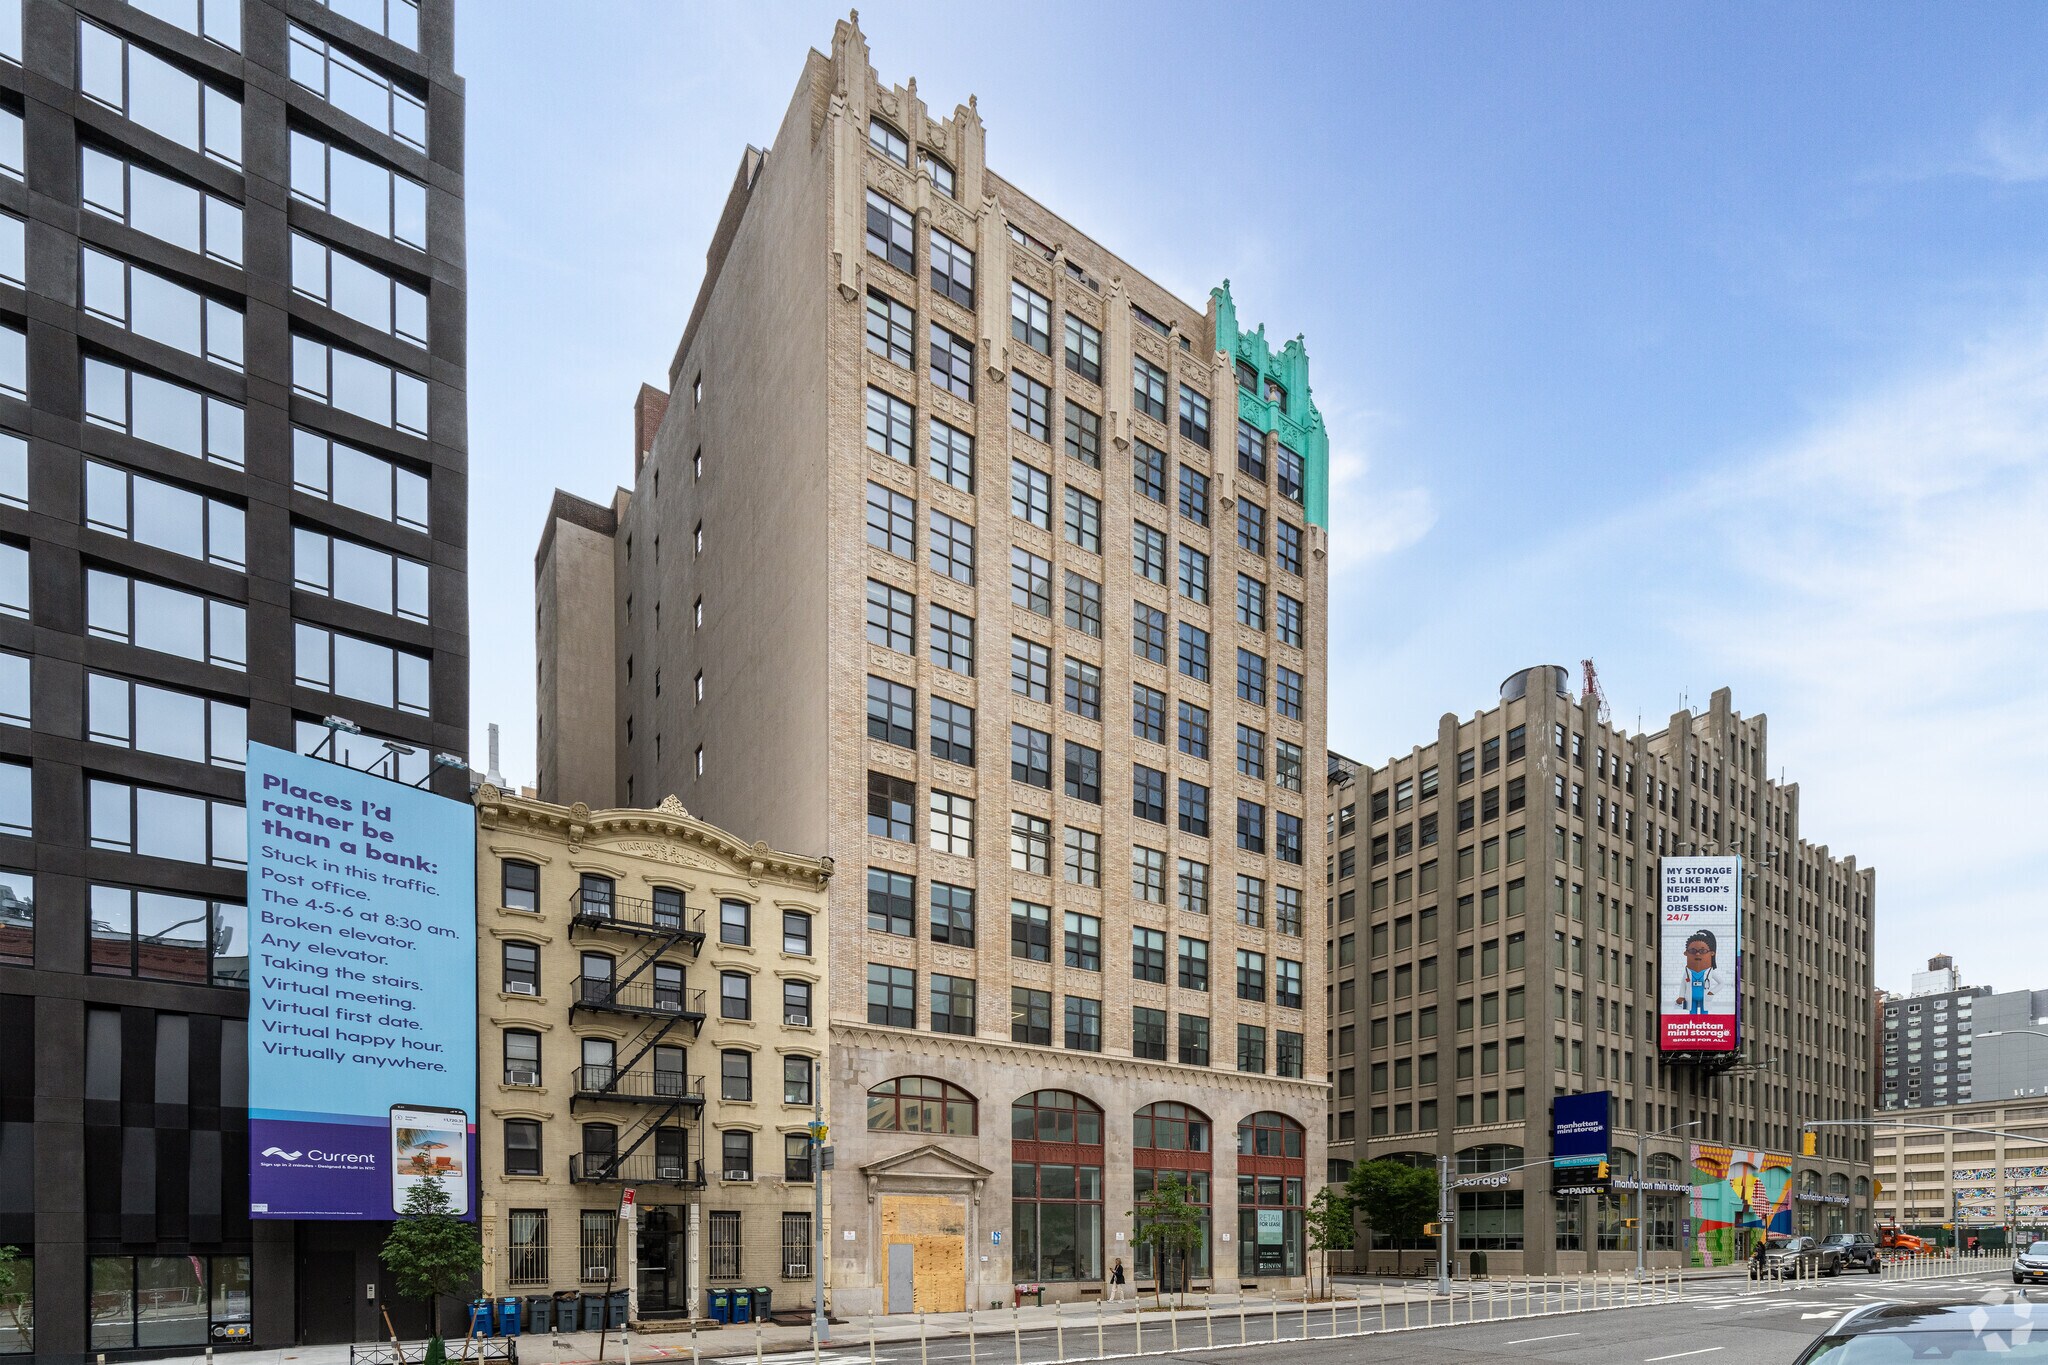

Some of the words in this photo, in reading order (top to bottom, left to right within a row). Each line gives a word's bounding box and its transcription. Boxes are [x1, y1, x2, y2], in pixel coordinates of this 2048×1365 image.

[263, 773, 352, 812] Places
[362, 800, 392, 822] I'd
[262, 798, 354, 833] rather
[362, 821, 395, 843] be
[261, 819, 331, 849] than
[340, 839, 357, 855] a
[365, 842, 439, 875] bank:
[261, 845, 318, 869] Stuck
[323, 858, 340, 874] in
[344, 864, 377, 882] this
[382, 873, 440, 897] traffic.
[1666, 867, 1683, 875] MY
[1685, 867, 1732, 875] STORAGE
[1666, 876, 1677, 884] IS
[1679, 876, 1702, 884] LIKE
[1704, 876, 1720, 884] MY
[261, 867, 305, 887] Post
[311, 879, 371, 901] office.
[1666, 885, 1730, 894] NEIGHBOR'S
[1666, 895, 1689, 903] EDM
[1666, 904, 1728, 912] OBSESSION:
[261, 888, 299, 908] The
[360, 909, 379, 923] at
[385, 914, 422, 932] 8:30
[427, 923, 460, 940] am.
[261, 911, 333, 935] Broken
[339, 927, 417, 951] elevator.
[261, 933, 301, 952] Any
[308, 942, 389, 966] elevator.
[261, 954, 329, 978] Taking
[335, 965, 366, 982] the
[371, 972, 424, 991] stairs.
[262, 975, 329, 997] Virtual
[335, 988, 416, 1011] meeting.
[262, 997, 329, 1018] Virtual
[335, 1007, 372, 1024] first
[378, 1014, 423, 1030] date.
[1667, 1019, 1723, 1030] manhattan
[262, 1019, 329, 1039] Virtual
[335, 1027, 396, 1048] happy
[401, 1037, 444, 1053] hour.
[1690, 1029, 1730, 1039] storage
[262, 1041, 346, 1063] Virtually
[352, 1053, 448, 1073] anywhere.
[1556, 1120, 1599, 1130] manhattan
[1573, 1125, 1603, 1133] storage
[308, 1149, 376, 1164] Current
[1456, 1176, 1508, 1188] storage
[1569, 1186, 1596, 1195] PARK
[1614, 1175, 1653, 1190] manhatan
[1654, 1182, 1668, 1190] mini
[1668, 1183, 1694, 1194] storage
